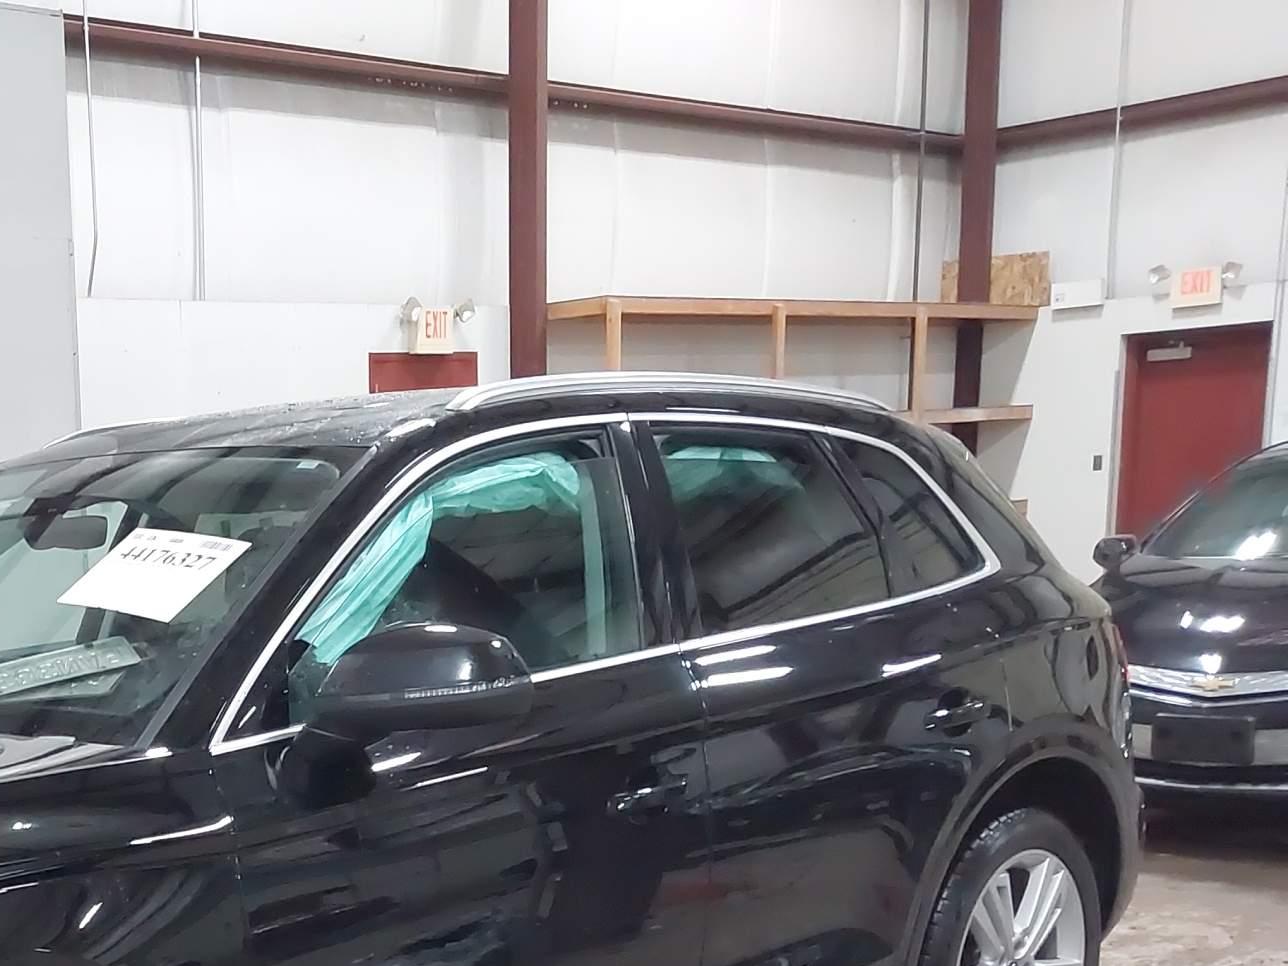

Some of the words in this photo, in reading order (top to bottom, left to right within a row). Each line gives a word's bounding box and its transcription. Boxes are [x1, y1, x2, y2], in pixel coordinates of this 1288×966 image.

[1180, 270, 1215, 295] EXIT
[425, 310, 448, 339] EXIT
[120, 546, 217, 570] 44176327
